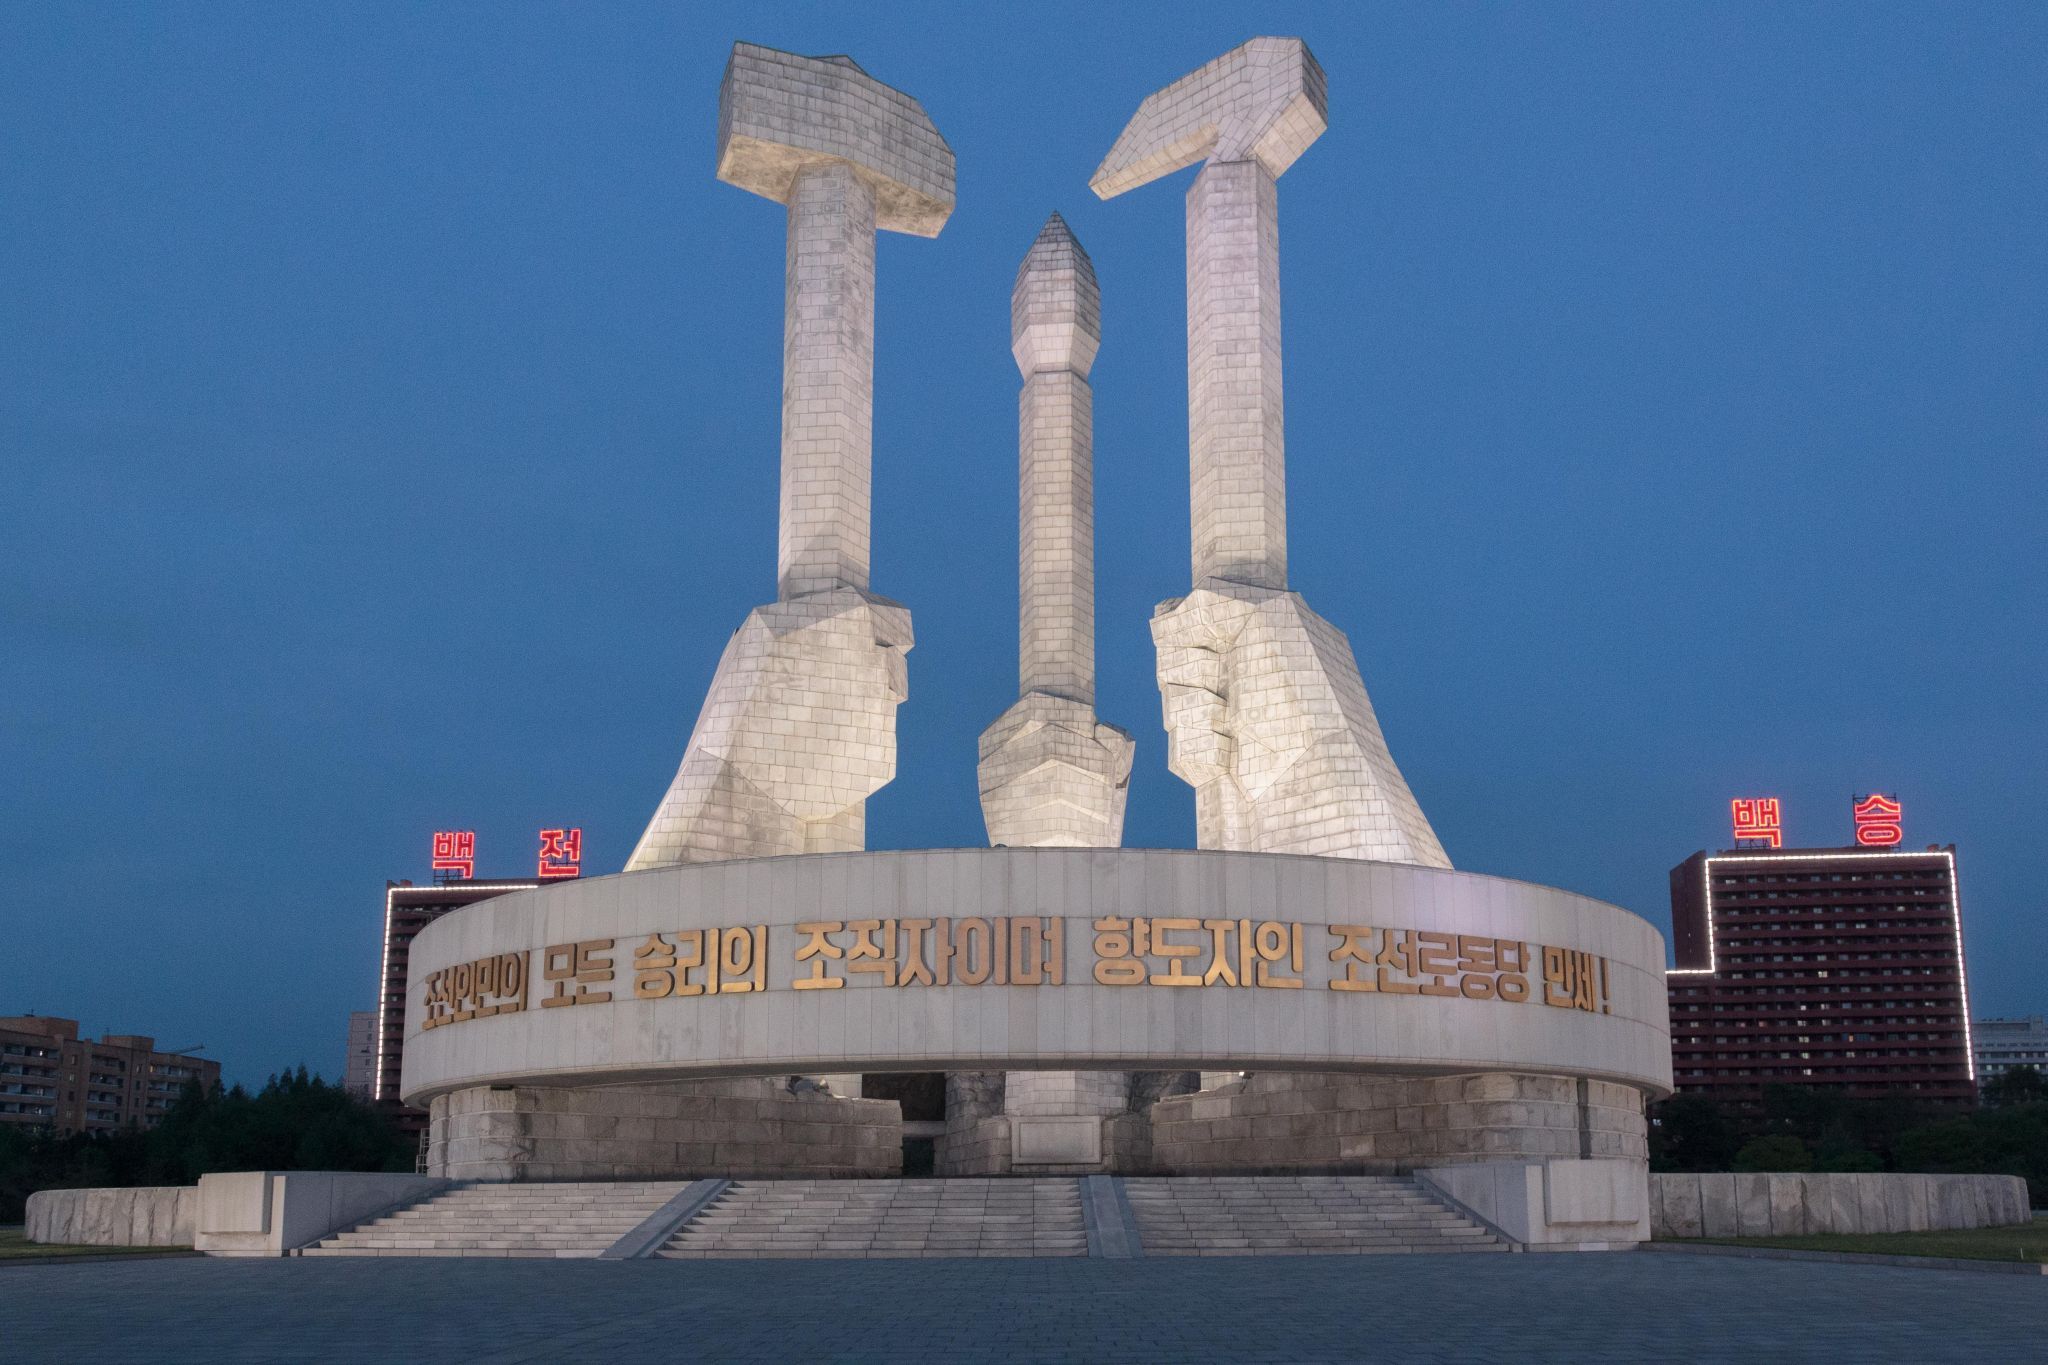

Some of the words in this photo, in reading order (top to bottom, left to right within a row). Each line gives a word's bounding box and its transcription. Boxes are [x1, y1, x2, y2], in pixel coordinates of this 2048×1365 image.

[422, 950, 530, 1031] 조선인민의
[541, 938, 615, 1008] 모든
[633, 924, 769, 999] 승리의
[792, 916, 1063, 989] 조직자이며
[1092, 914, 1305, 989] 향도자인
[1328, 923, 1531, 1002] 조선로동당
[1541, 945, 1612, 1015] 만세!
